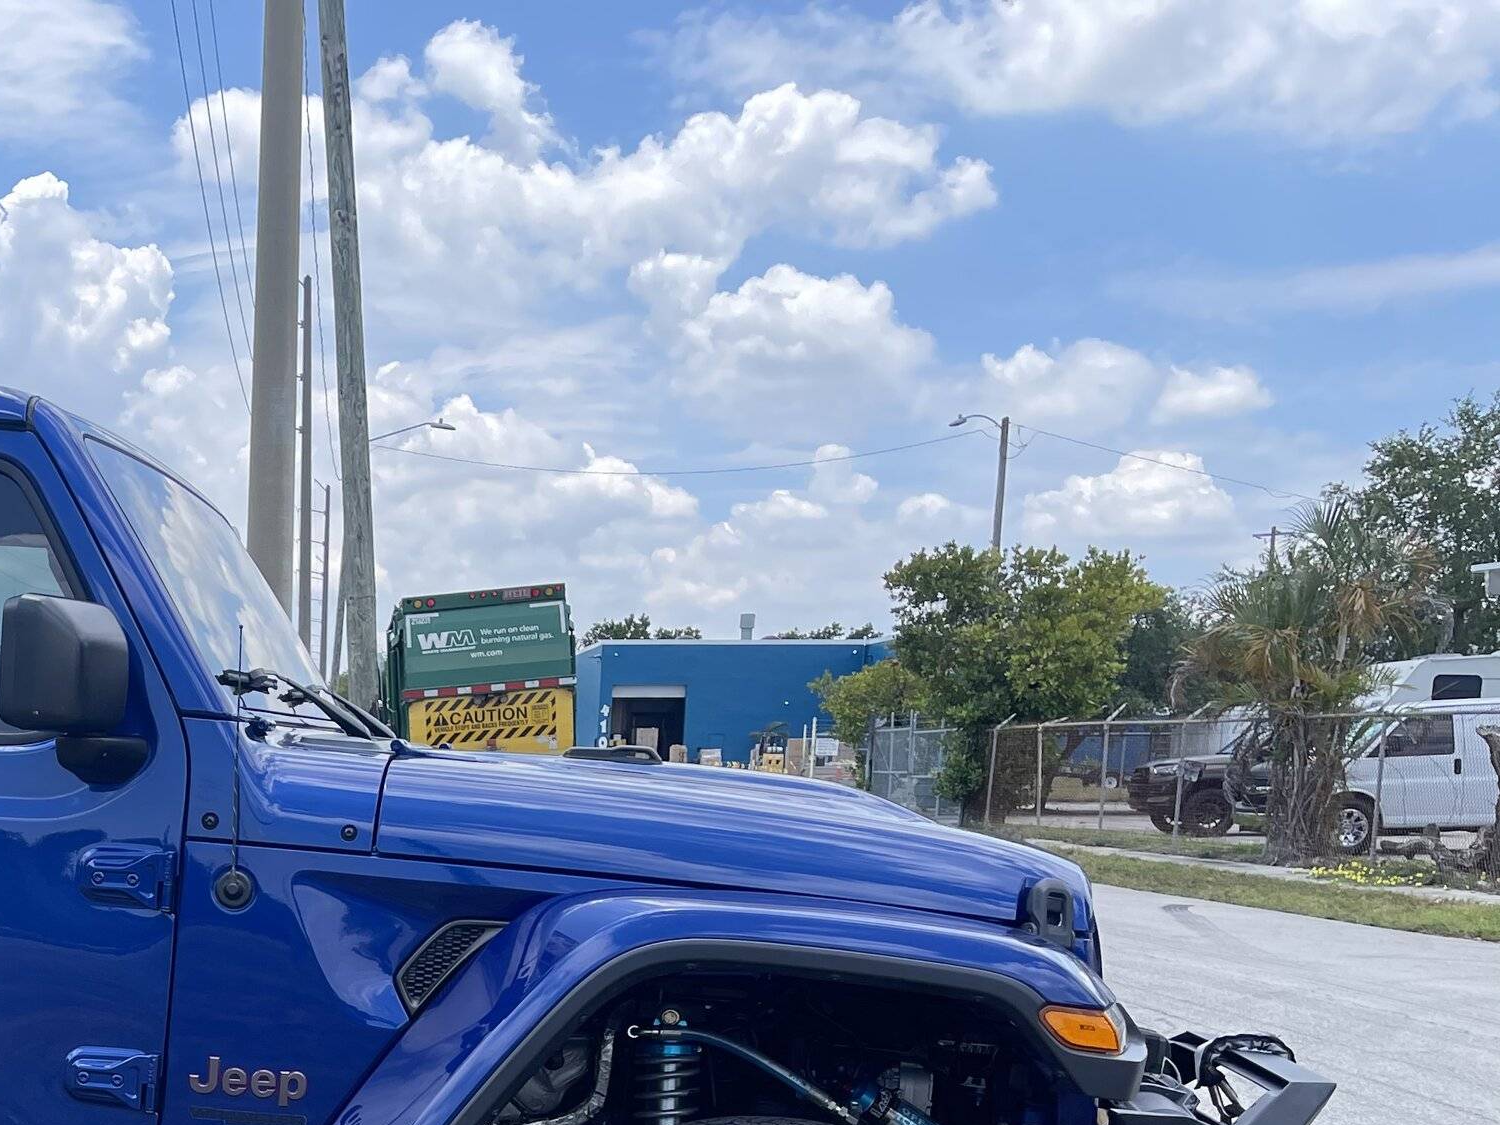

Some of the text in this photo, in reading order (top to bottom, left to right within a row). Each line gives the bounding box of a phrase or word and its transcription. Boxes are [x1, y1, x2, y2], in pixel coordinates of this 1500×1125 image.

[480, 628, 493, 637] We
[494, 627, 506, 635] run
[519, 624, 539, 632] clean
[481, 634, 510, 645] burning
[512, 632, 538, 642] natural
[417, 629, 476, 650] WM
[470, 649, 503, 658] wm.com
[450, 706, 528, 725] CAUTION
[189, 1056, 308, 1107] Jeep
